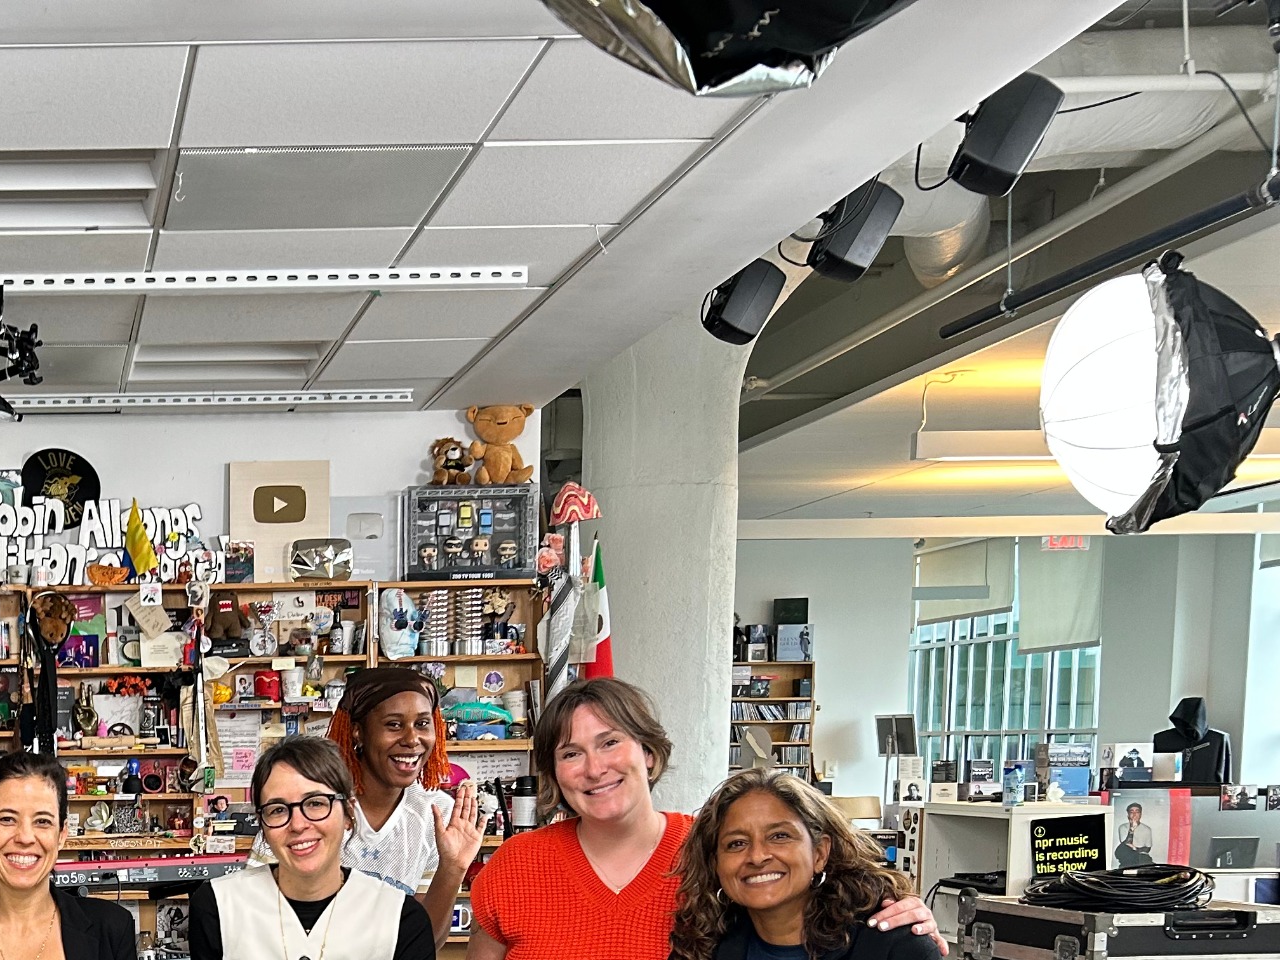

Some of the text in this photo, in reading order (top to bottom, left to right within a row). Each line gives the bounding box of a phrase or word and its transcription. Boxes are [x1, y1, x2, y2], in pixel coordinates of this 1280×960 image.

[37, 451, 78, 471] LOVE
[78, 498, 121, 549] All
[1035, 834, 1089, 850] npr music
[1035, 846, 1099, 861] is recording
[1036, 860, 1088, 875] this show
